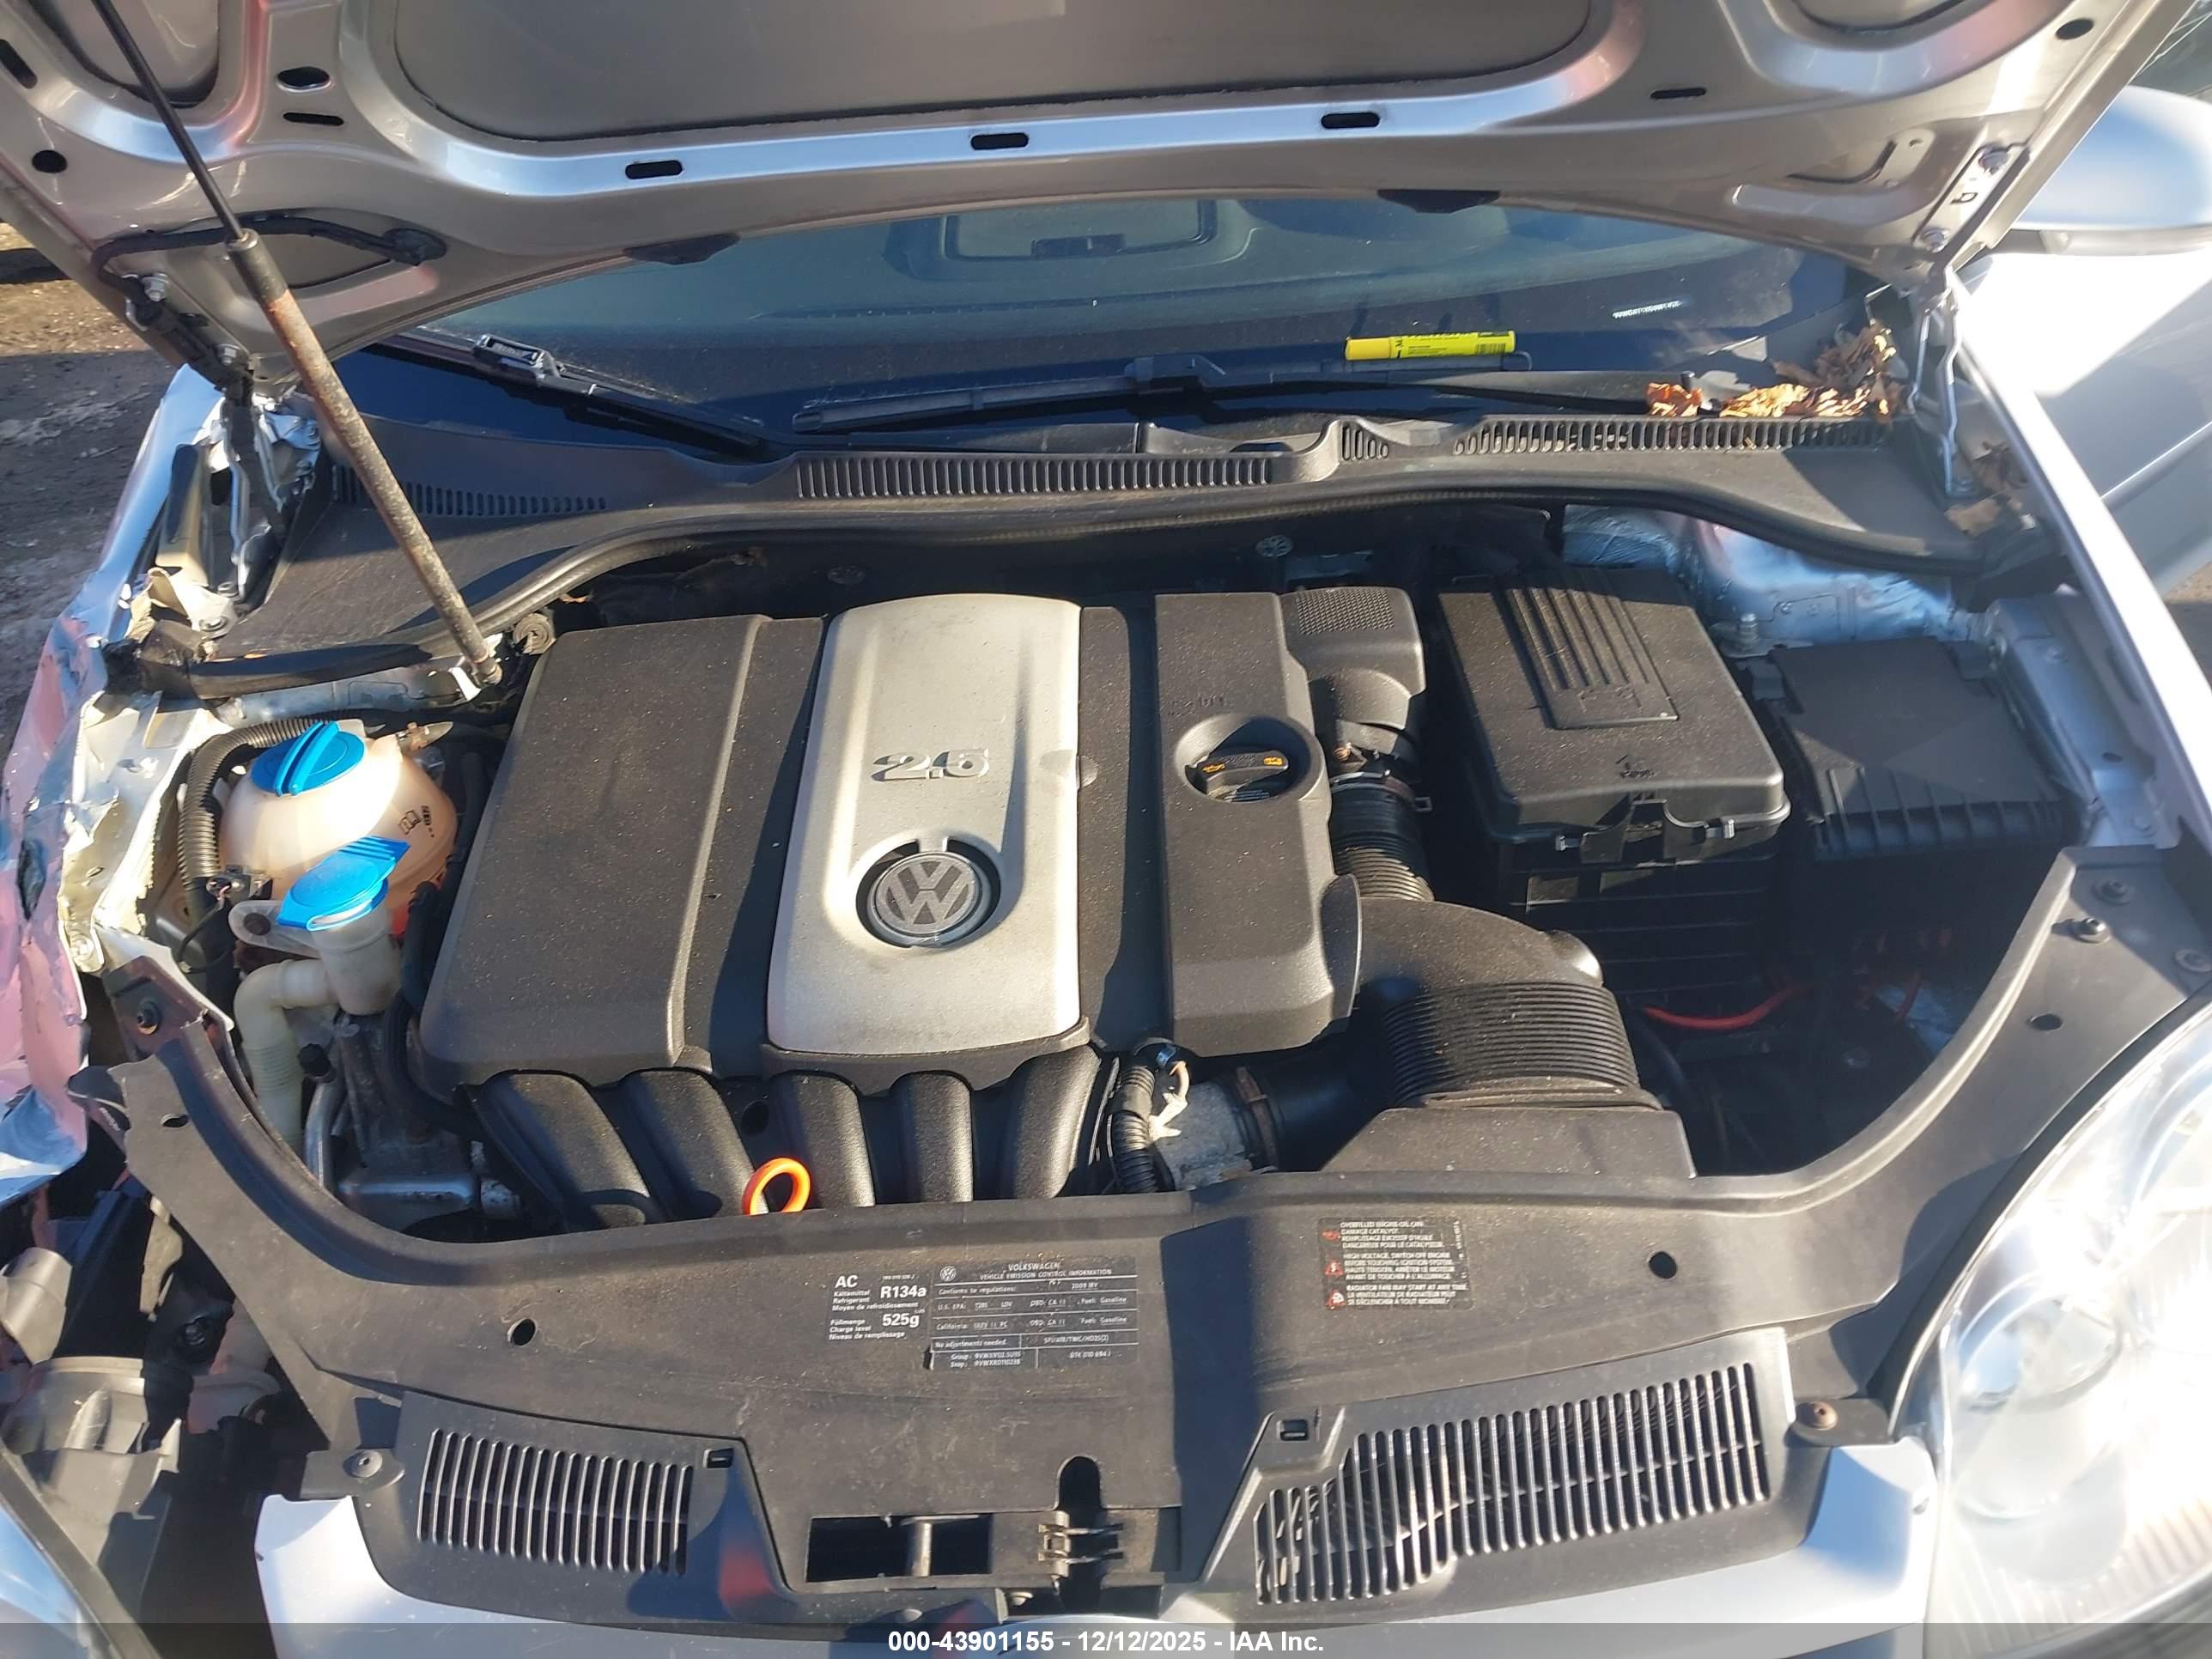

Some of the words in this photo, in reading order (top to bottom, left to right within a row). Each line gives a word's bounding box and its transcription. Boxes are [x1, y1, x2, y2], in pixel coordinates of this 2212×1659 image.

[872, 749, 989, 781] 2.5
[1008, 1261, 1060, 1271] VOLKSWAGEN
[835, 1275, 858, 1288] AC
[980, 1272, 1005, 1280] VEHICLE
[880, 1285, 927, 1298] R134a
[882, 1313, 920, 1328] 525g
[945, 1340, 982, 1349] adjustments
